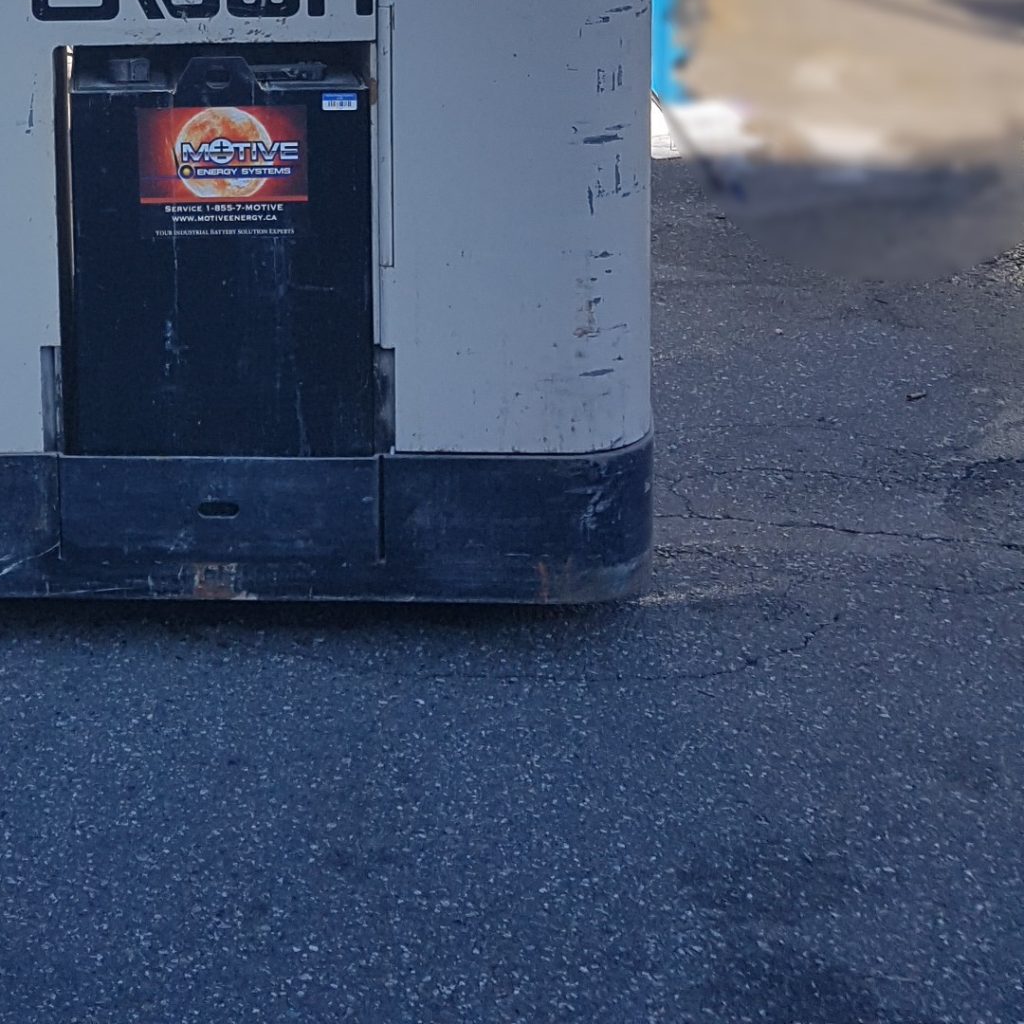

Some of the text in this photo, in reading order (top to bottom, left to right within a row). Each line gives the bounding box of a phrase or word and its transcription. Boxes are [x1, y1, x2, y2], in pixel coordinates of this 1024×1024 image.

[181, 138, 299, 164] MOTIVE
[197, 167, 291, 176] ENERGY SYSTEMS
[206, 203, 284, 212] 1-855-7-MOTIVE
[172, 214, 278, 223] WWW.MOTIVEENERGY.CA
